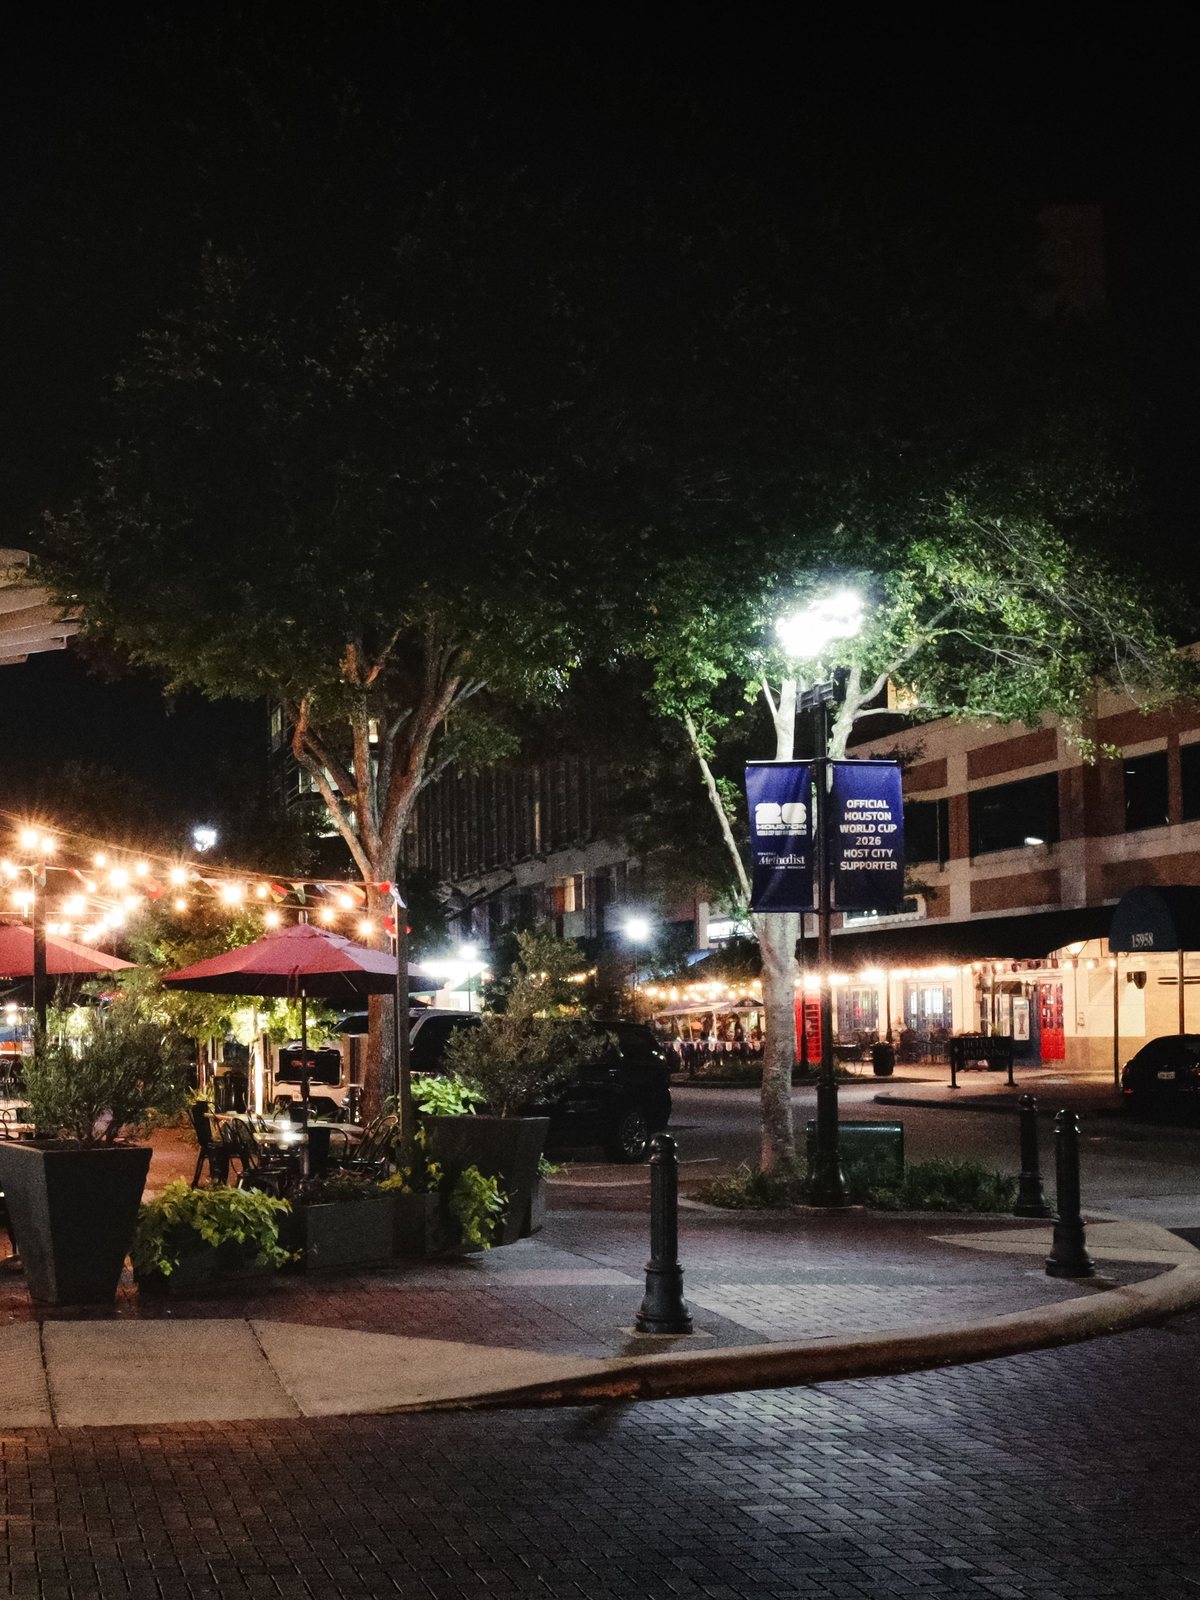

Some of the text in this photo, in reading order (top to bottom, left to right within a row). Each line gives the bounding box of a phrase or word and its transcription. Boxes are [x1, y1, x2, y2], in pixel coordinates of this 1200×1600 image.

[846, 800, 890, 809] OFFICIAL
[755, 802, 807, 824] 26
[844, 811, 892, 821] HOUSTON
[839, 823, 898, 834] WORLD CUP
[855, 836, 882, 846] 2026
[843, 848, 894, 858] HOST CITY
[758, 853, 806, 865] Methodist
[840, 861, 898, 870] SUPPORTER
[1131, 932, 1154, 948] 15958
